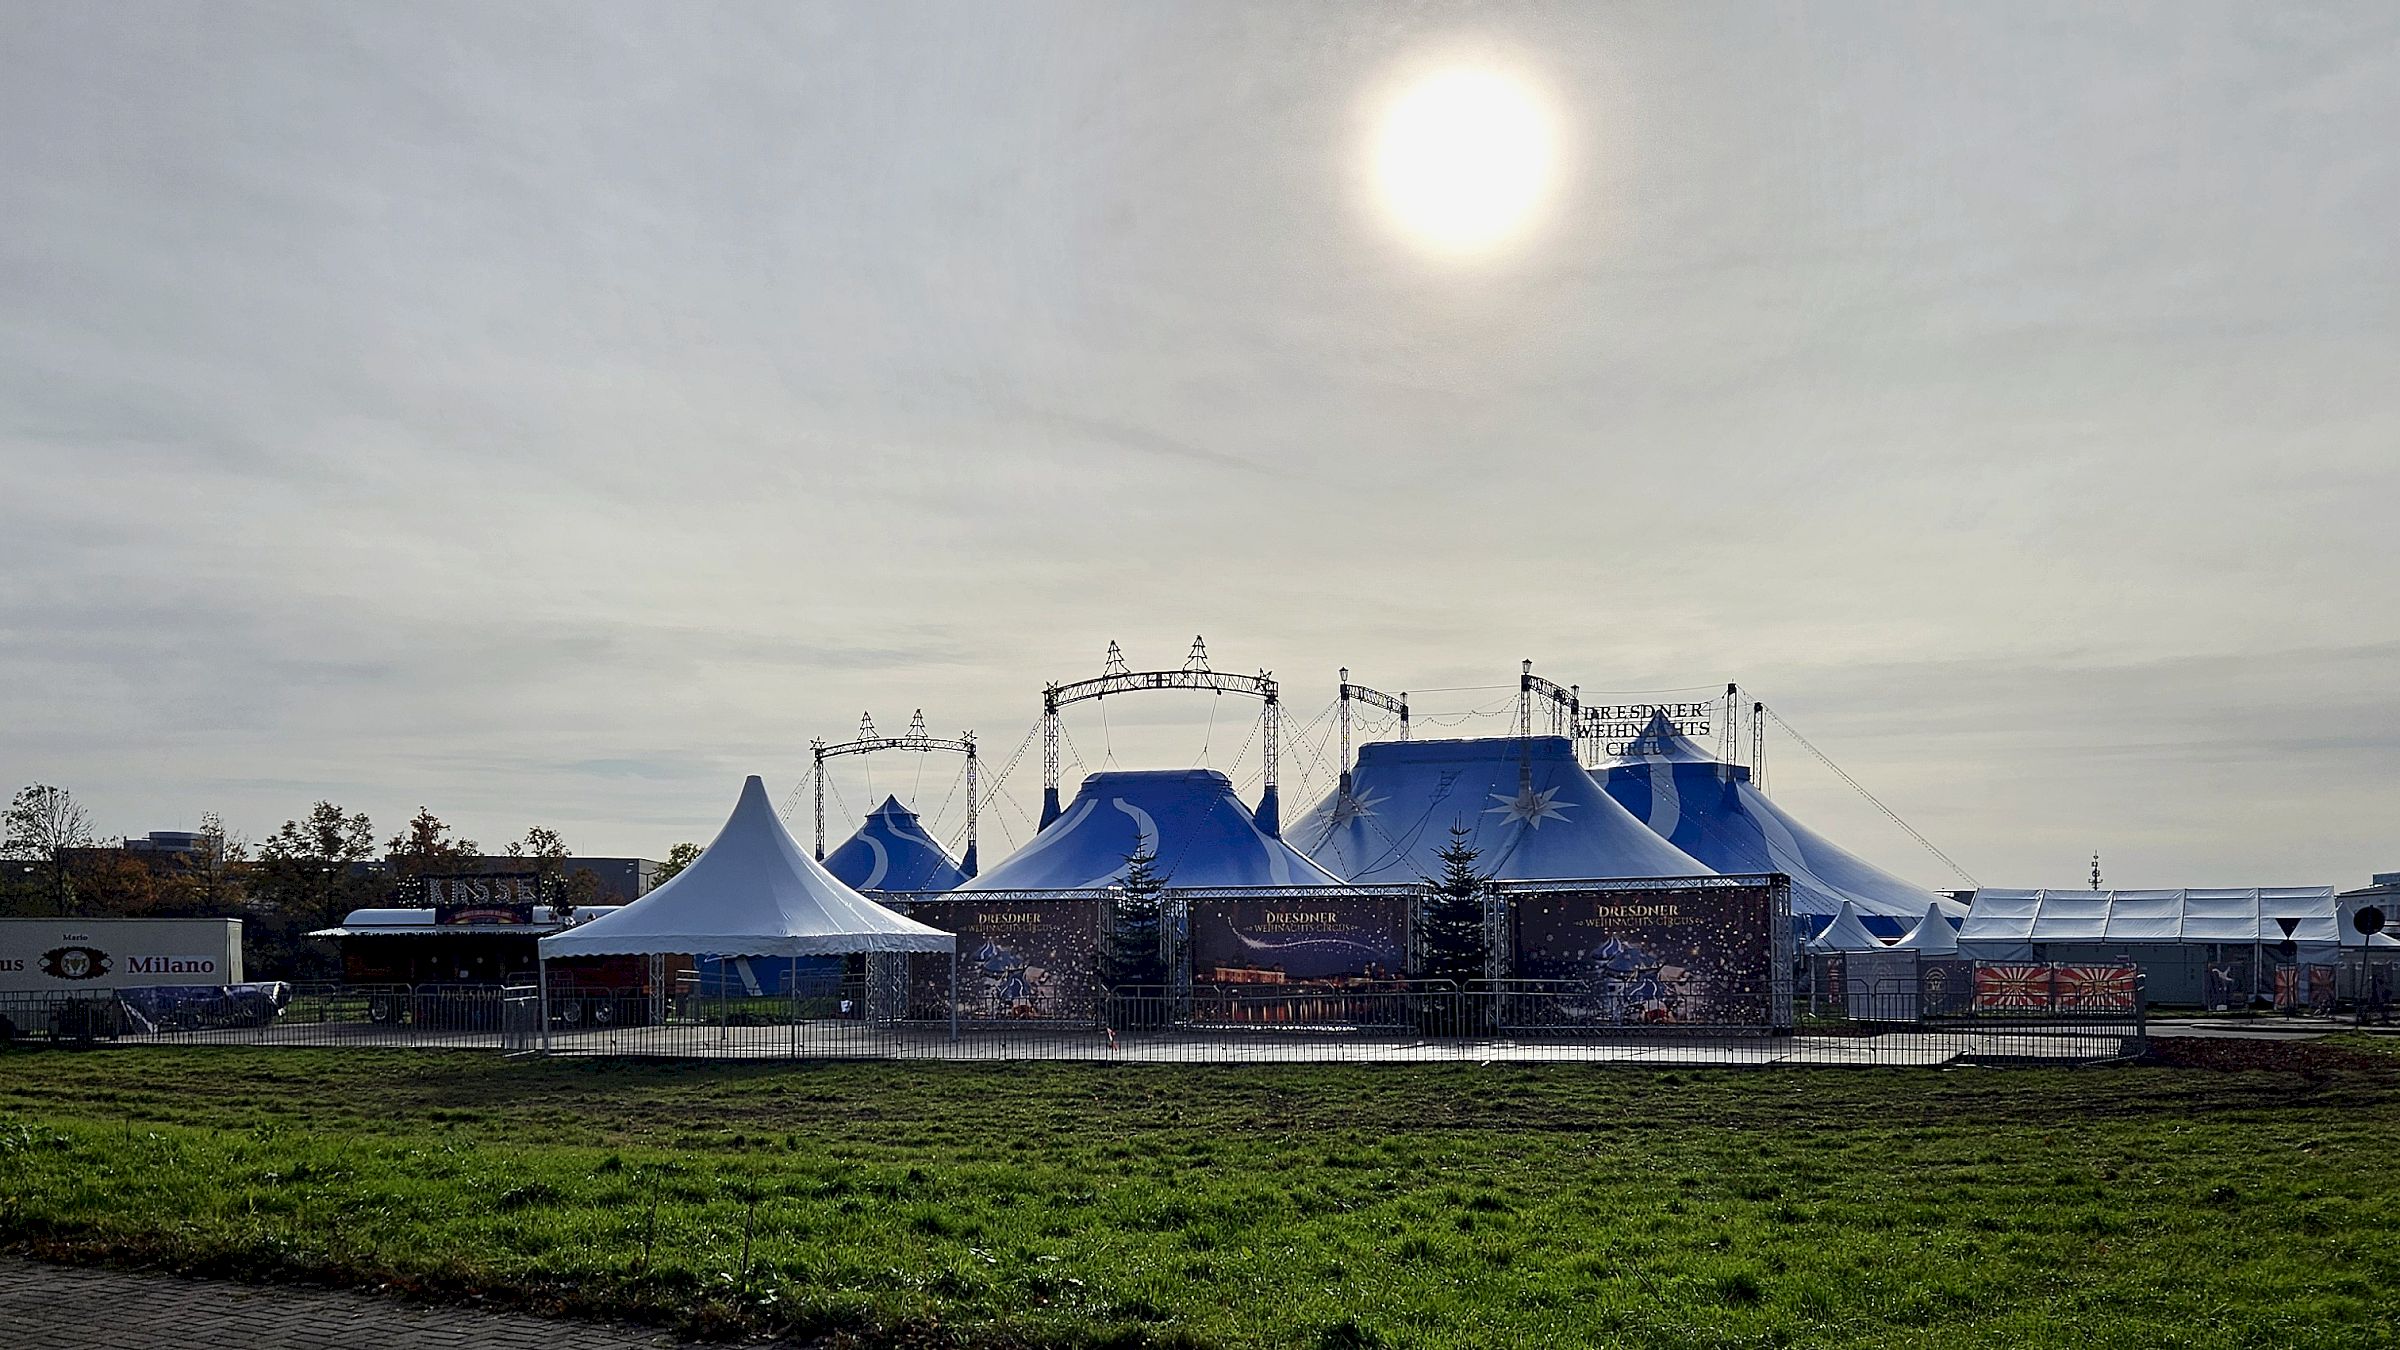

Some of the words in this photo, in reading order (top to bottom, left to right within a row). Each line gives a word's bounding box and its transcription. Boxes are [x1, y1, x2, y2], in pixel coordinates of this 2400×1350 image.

[1584, 704, 1704, 720] DRESDNER
[428, 877, 537, 906] KASSE
[978, 912, 1041, 924] DRESDNER
[1265, 910, 1337, 923] DRESDNER
[1598, 904, 1679, 918] DRESDNER
[62, 933, 89, 942] Mario
[127, 955, 215, 974] Milano
